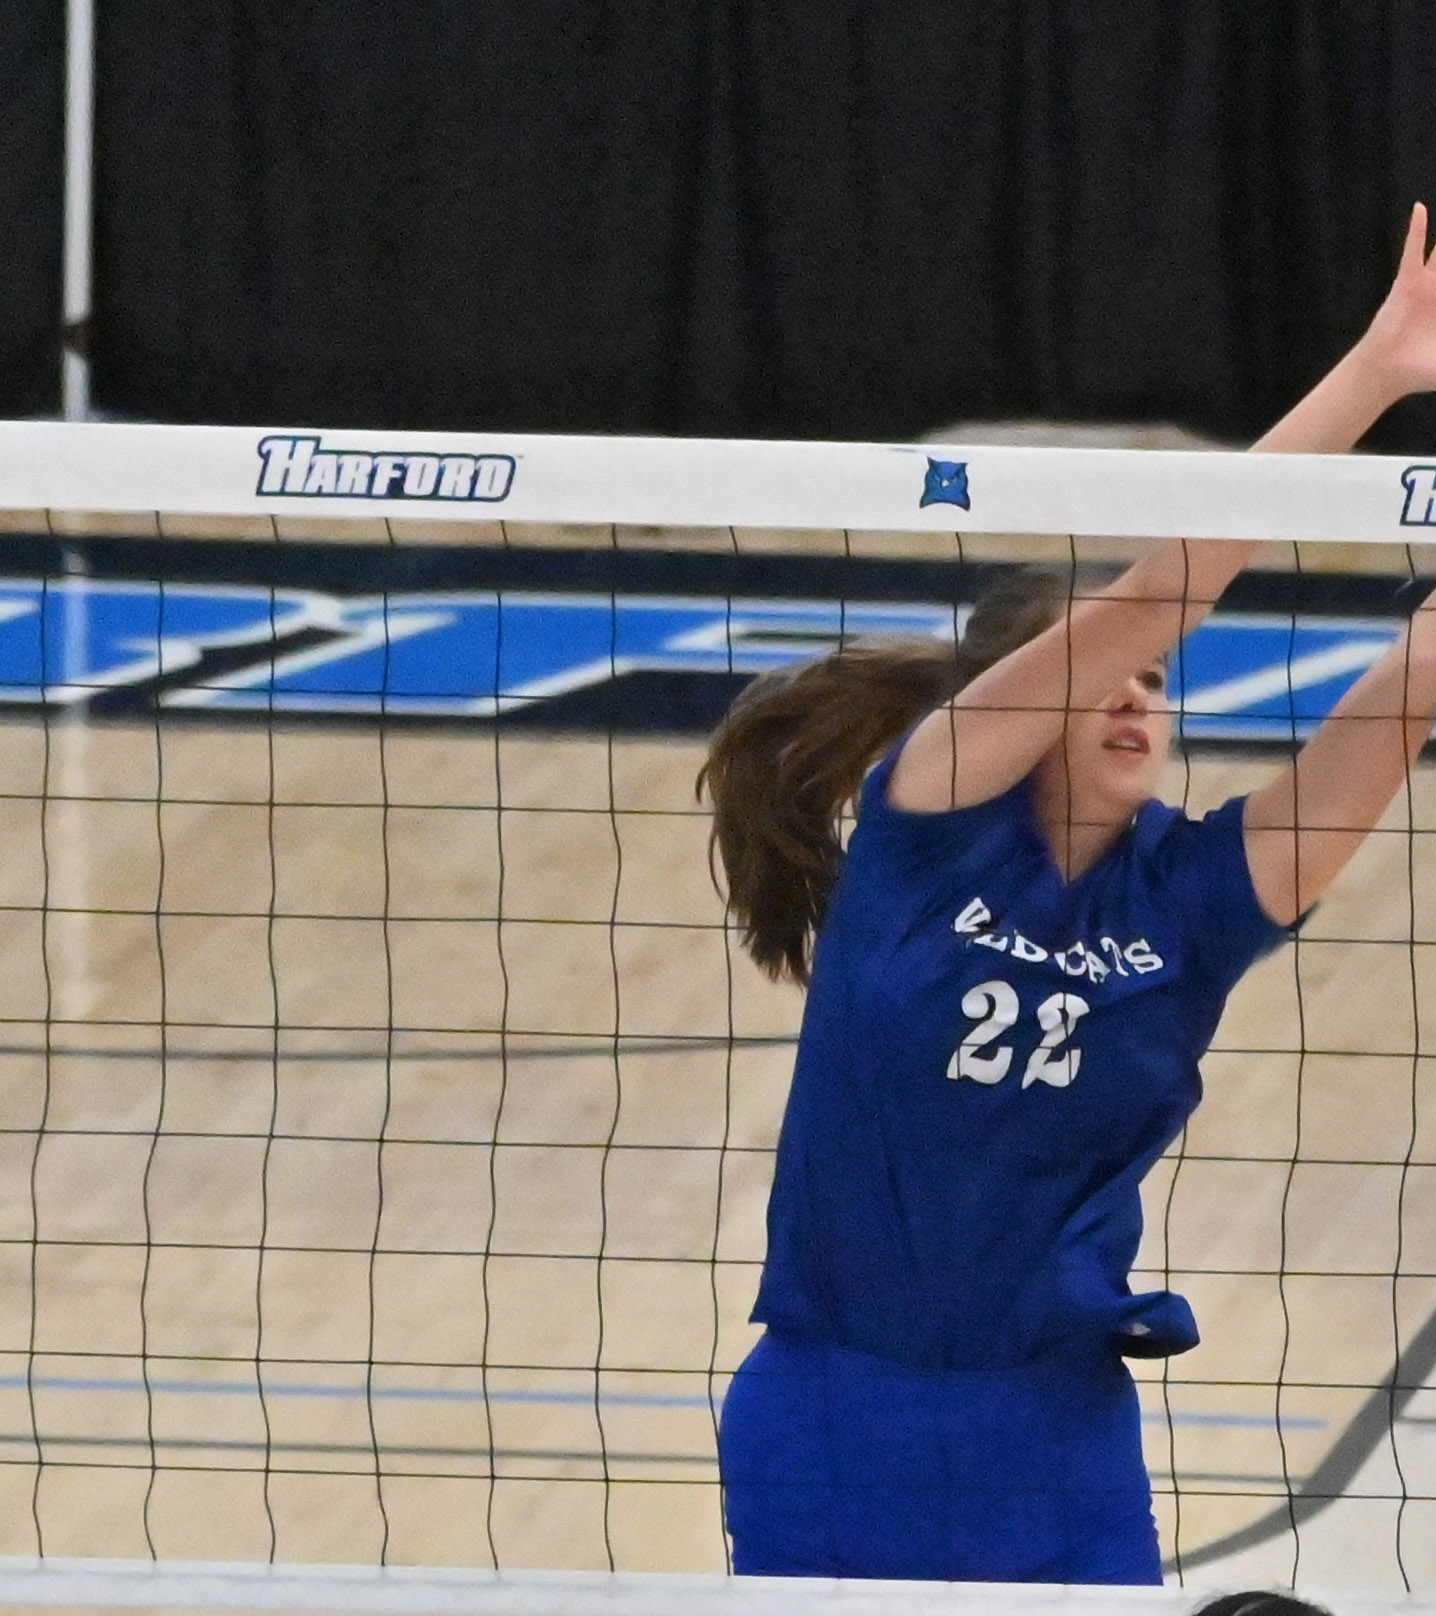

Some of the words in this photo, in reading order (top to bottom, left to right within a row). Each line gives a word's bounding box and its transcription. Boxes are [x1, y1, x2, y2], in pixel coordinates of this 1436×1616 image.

[256, 435, 517, 503] HARFORD
[954, 897, 1164, 984] WLDCATS
[946, 980, 1091, 1090] 22
